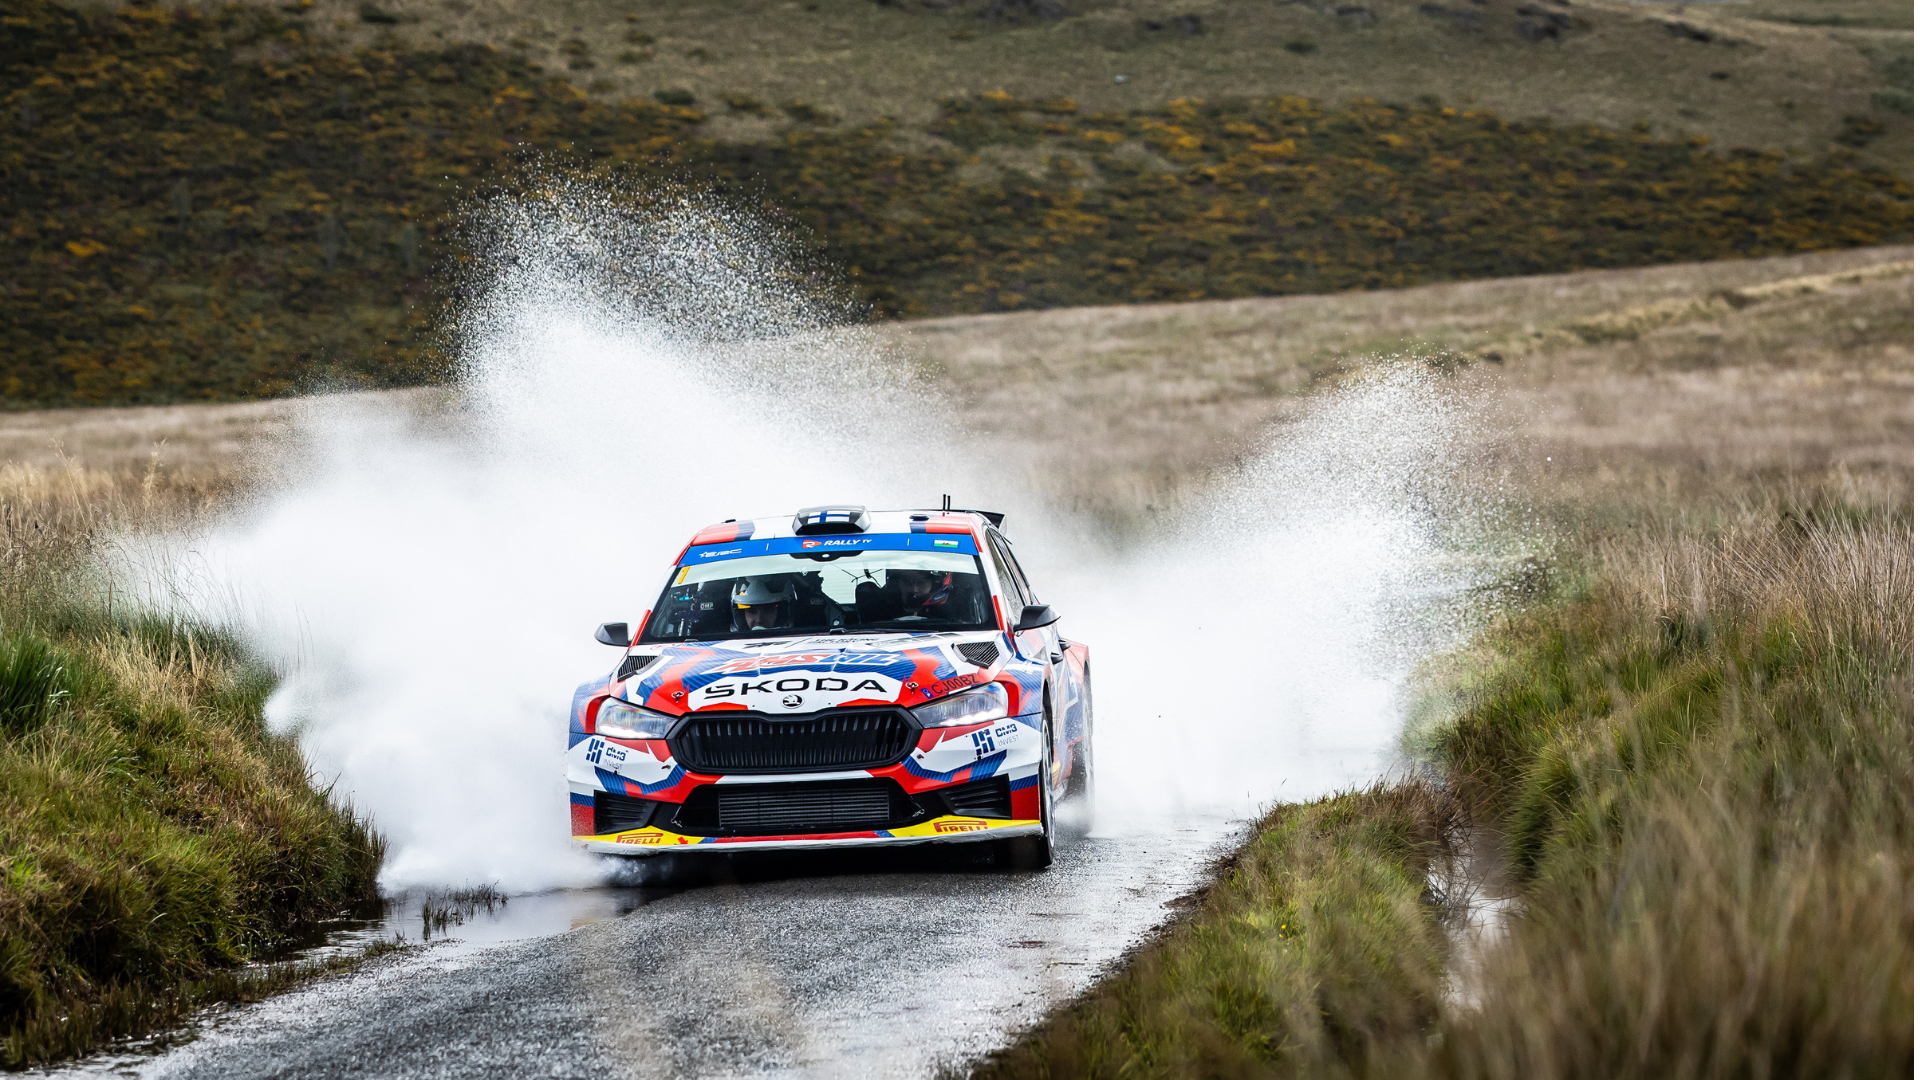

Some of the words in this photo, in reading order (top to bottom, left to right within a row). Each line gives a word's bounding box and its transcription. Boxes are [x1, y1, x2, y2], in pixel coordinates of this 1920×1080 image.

[678, 566, 690, 584] 1
[997, 735, 1019, 746] INVEST
[616, 833, 663, 844] PIRELLI
